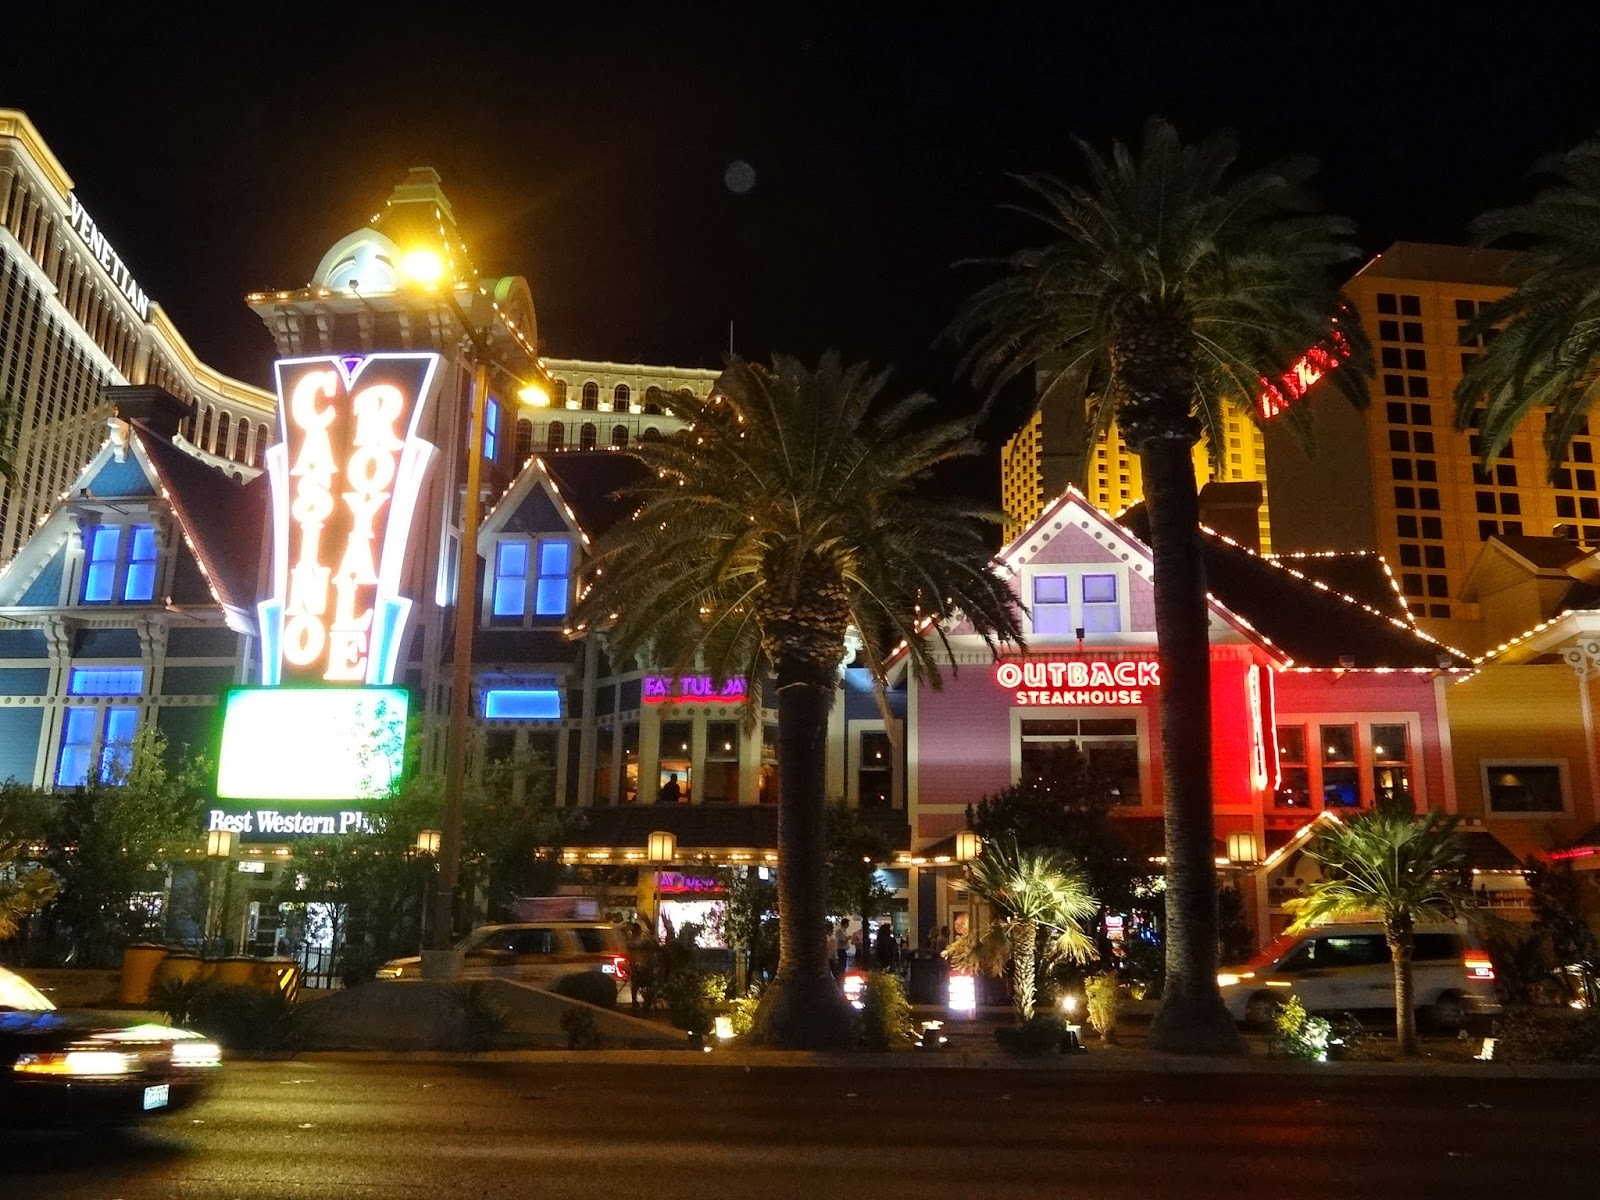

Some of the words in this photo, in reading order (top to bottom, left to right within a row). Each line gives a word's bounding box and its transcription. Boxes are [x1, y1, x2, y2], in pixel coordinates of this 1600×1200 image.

[69, 191, 149, 320] VENETIAN
[283, 370, 339, 666] CASINO
[323, 384, 404, 681] ROYALE
[996, 662, 1161, 688] OUTBACK
[1016, 690, 1143, 705] STEAKHOUSE
[208, 810, 253, 834] Best
[256, 810, 336, 835] Western
